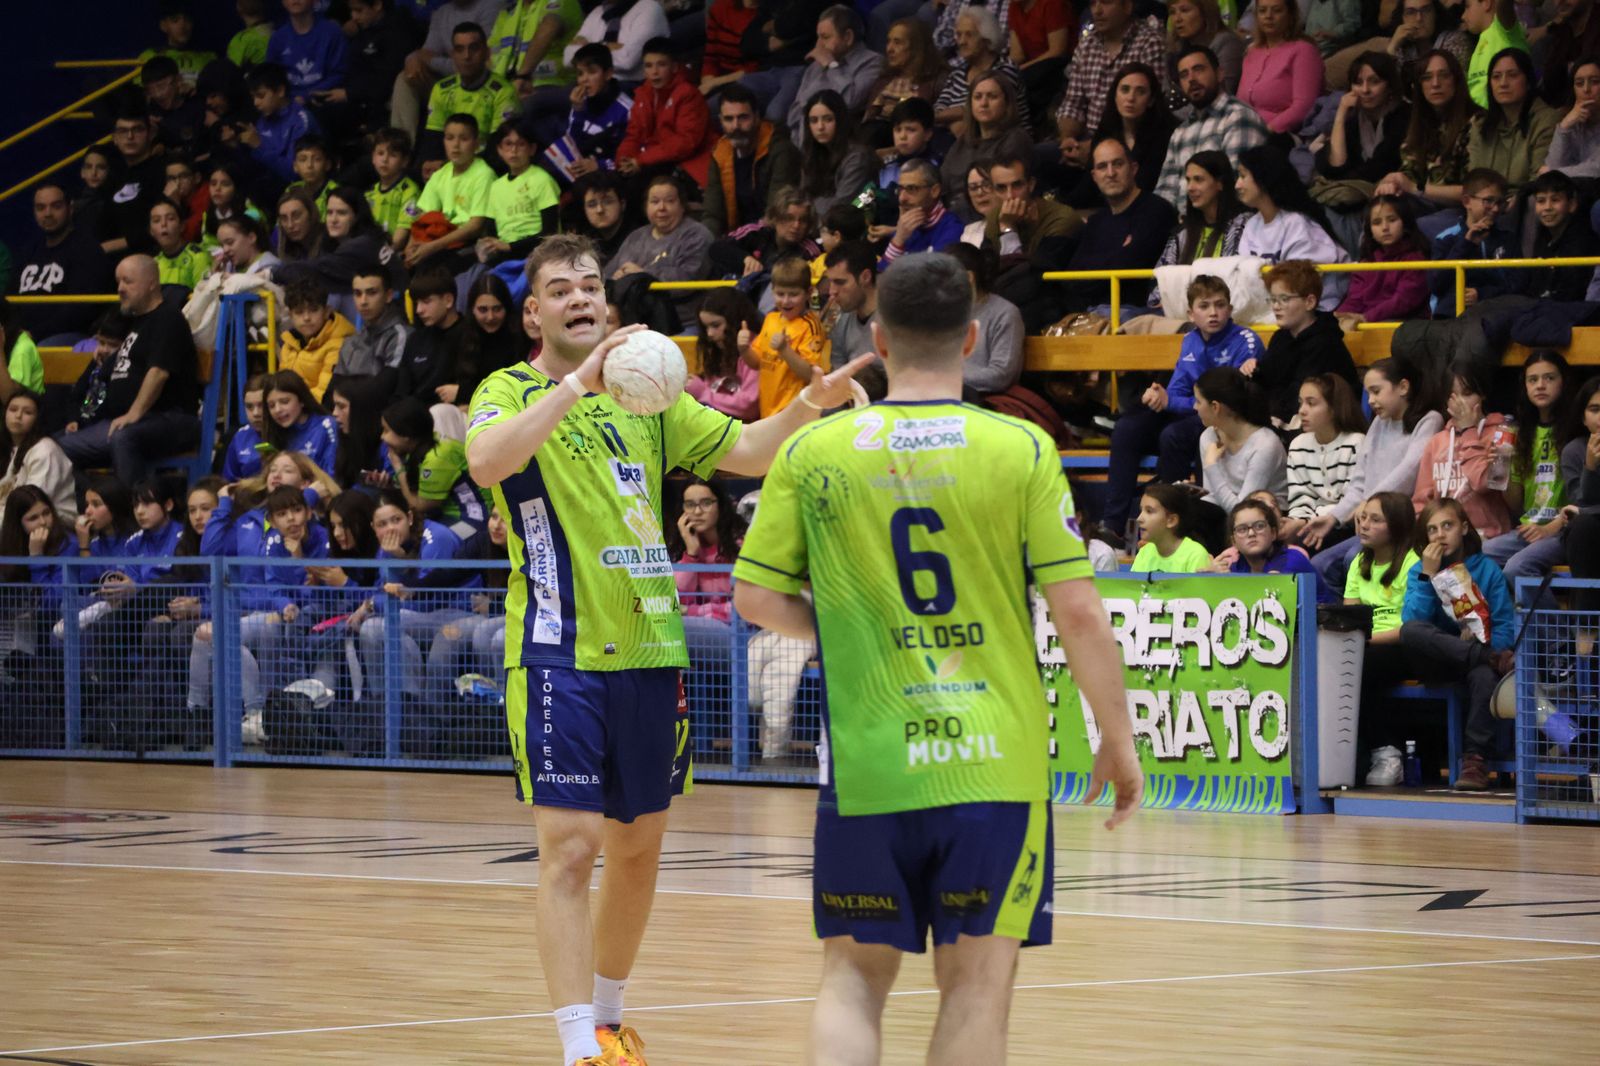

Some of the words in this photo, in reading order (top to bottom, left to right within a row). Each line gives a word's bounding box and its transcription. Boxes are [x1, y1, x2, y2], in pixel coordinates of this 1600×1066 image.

[890, 432, 966, 451] ZAMORA
[529, 505, 542, 534] S.L.
[535, 538, 551, 600] PORNO,
[602, 549, 641, 565] CAJA
[890, 506, 957, 616] 6
[890, 622, 984, 650] VELOSO
[904, 716, 962, 743] PRO
[908, 734, 1004, 767] MOVIL
[1176, 774, 1284, 814] ZAMORA
